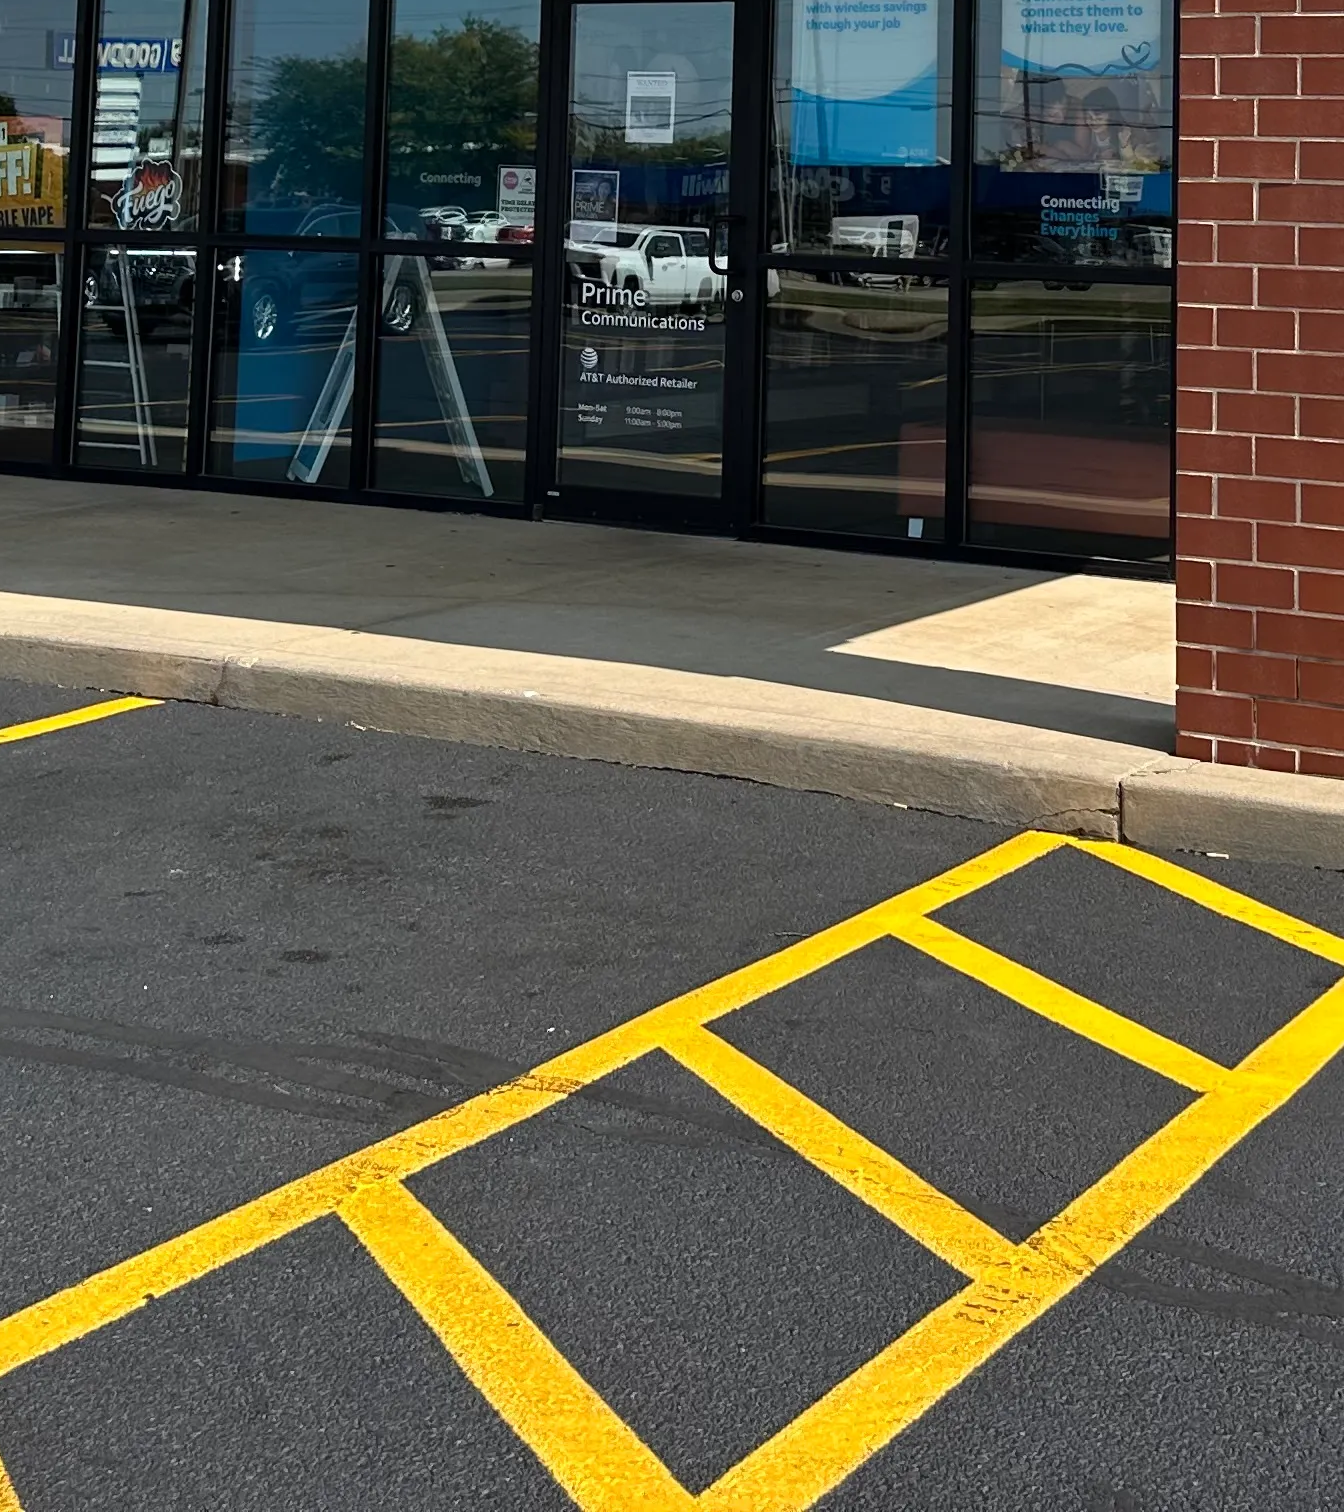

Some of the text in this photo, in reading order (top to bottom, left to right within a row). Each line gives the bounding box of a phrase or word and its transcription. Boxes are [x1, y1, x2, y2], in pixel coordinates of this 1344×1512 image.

[806, 0, 927, 15] with wireless savings
[1020, 4, 1143, 18] connects them to
[806, 16, 901, 33] through your job
[1020, 19, 1129, 36] what they love.
[1, 127, 7, 141] 1
[419, 171, 482, 187] Connecting
[117, 179, 176, 224] Fuego
[575, 200, 605, 213] PRIME
[1040, 194, 1121, 214] Connecting
[22, 205, 55, 226] VAPE
[1040, 208, 1101, 225] Changes
[1040, 222, 1119, 241] Everything
[581, 282, 647, 307] Prime
[581, 310, 706, 332] Communications
[579, 372, 699, 390] AT&T Authorized Retailer
[577, 414, 604, 425] Sunday
